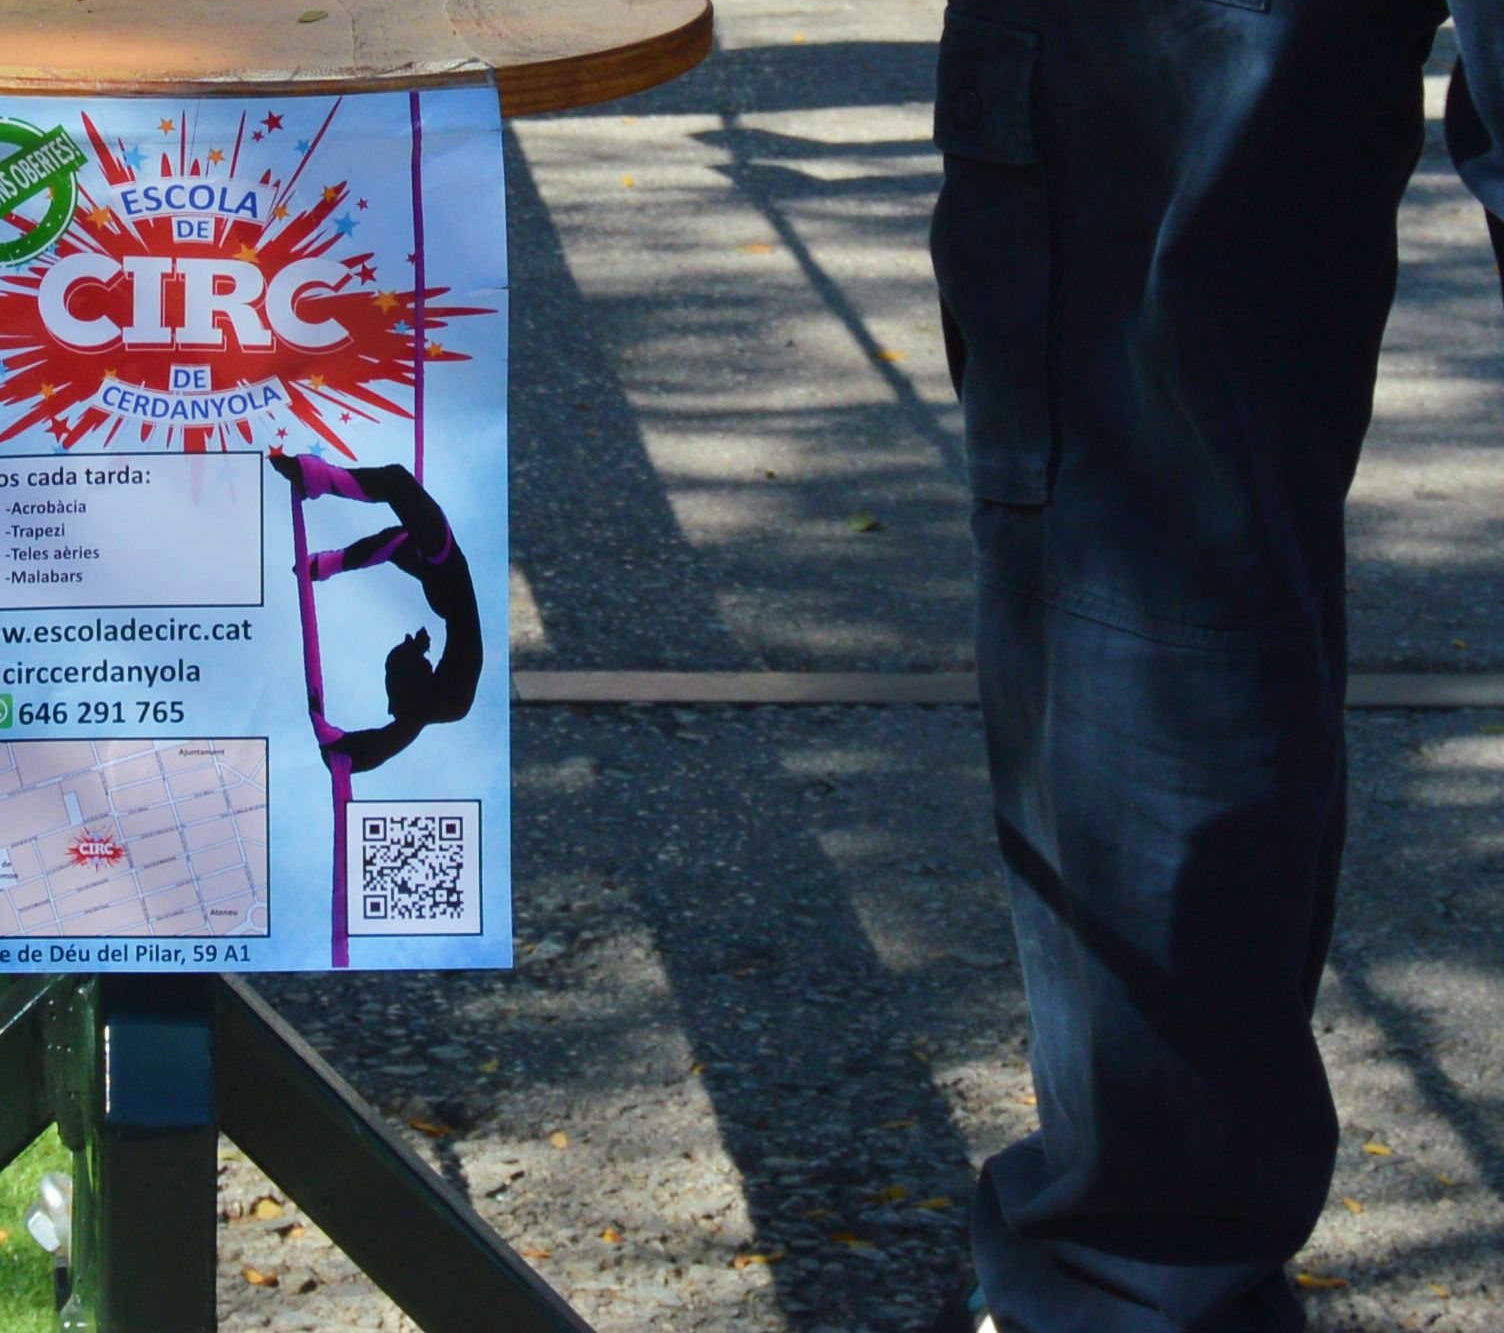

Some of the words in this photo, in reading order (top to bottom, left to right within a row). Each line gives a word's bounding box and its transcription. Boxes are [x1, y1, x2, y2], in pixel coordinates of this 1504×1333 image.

[9, 132, 82, 190] OBERTES!
[120, 184, 259, 219] ESCOLA
[176, 220, 210, 240] DE
[37, 251, 355, 353] CIRC
[173, 368, 207, 389] DE
[101, 385, 283, 421] CERDANYOLA
[26, 467, 77, 488] cada
[85, 465, 152, 486] tarda:
[5, 500, 87, 515] -Acrobàcia
[5, 523, 66, 540] -Trapezi
[5, 547, 49, 562] -Teles
[53, 545, 100, 560] aèries
[5, 569, 83, 584] -Malabars
[2, 659, 201, 687] circcerdanyola
[18, 701, 68, 725] 646
[77, 701, 126, 724] 291
[135, 700, 185, 723] 765
[179, 748, 225, 757] Ajuntament
[79, 843, 114, 856] CIRC
[1, 860, 12, 868] de
[17, 944, 42, 963] de
[49, 943, 90, 963] Déu
[97, 943, 129, 963] del
[135, 943, 186, 966] Pilar,
[193, 944, 218, 963] 59
[224, 943, 252, 962] A1
